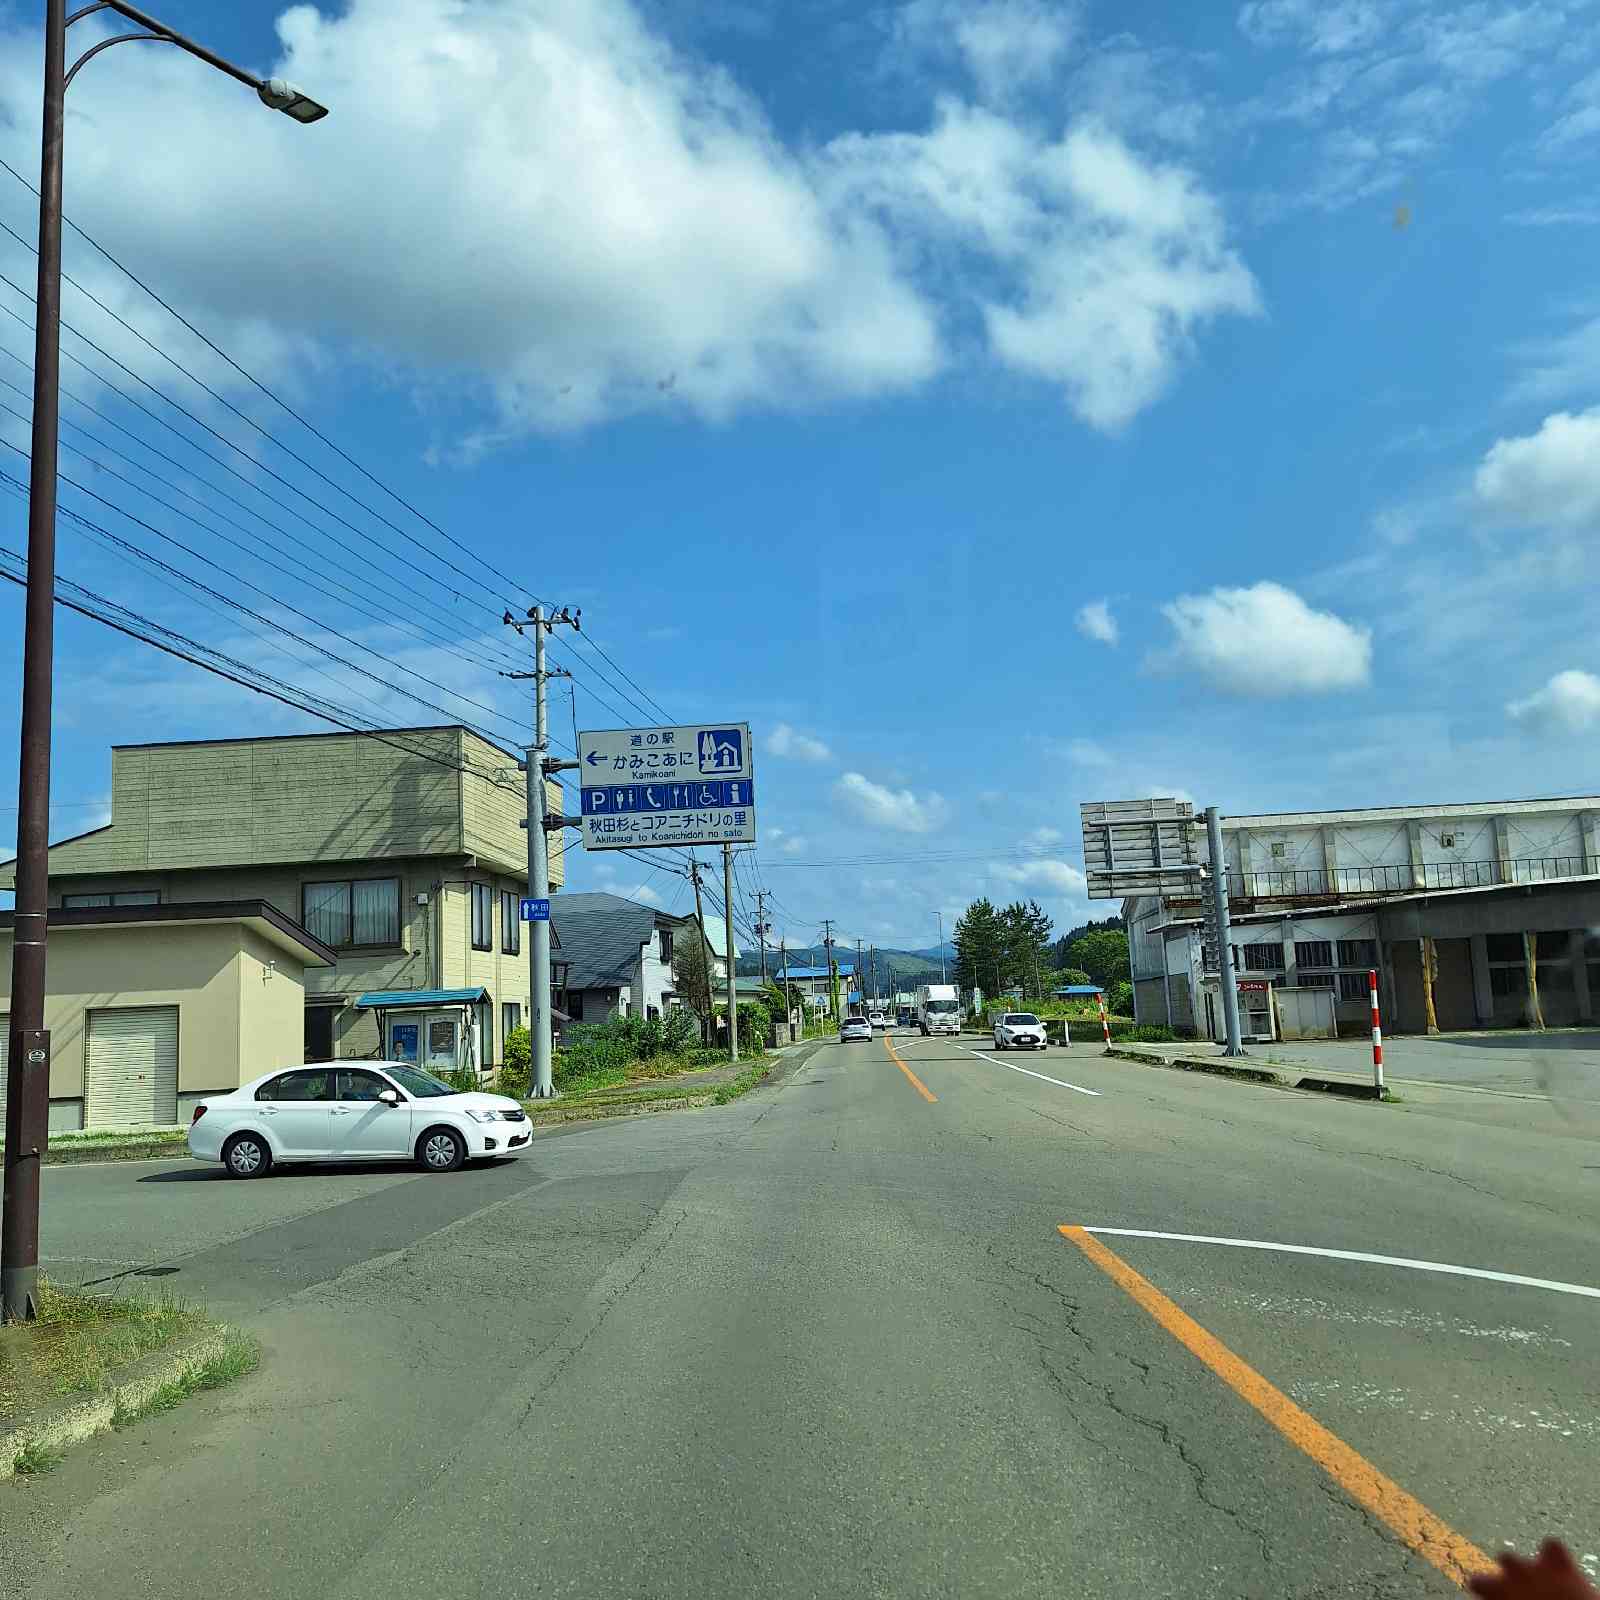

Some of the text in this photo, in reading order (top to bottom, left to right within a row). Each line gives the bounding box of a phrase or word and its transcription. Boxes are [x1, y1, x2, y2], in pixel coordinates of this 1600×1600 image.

[630, 731, 675, 747] 道の駅
[613, 751, 695, 770] かみこあに
[632, 770, 676, 780] Kamikoani
[588, 811, 748, 834] 秋田杉とコアニチドリの里
[595, 834, 633, 844] Akitasugi
[638, 833, 648, 842] to
[651, 830, 704, 841] Koanichidori
